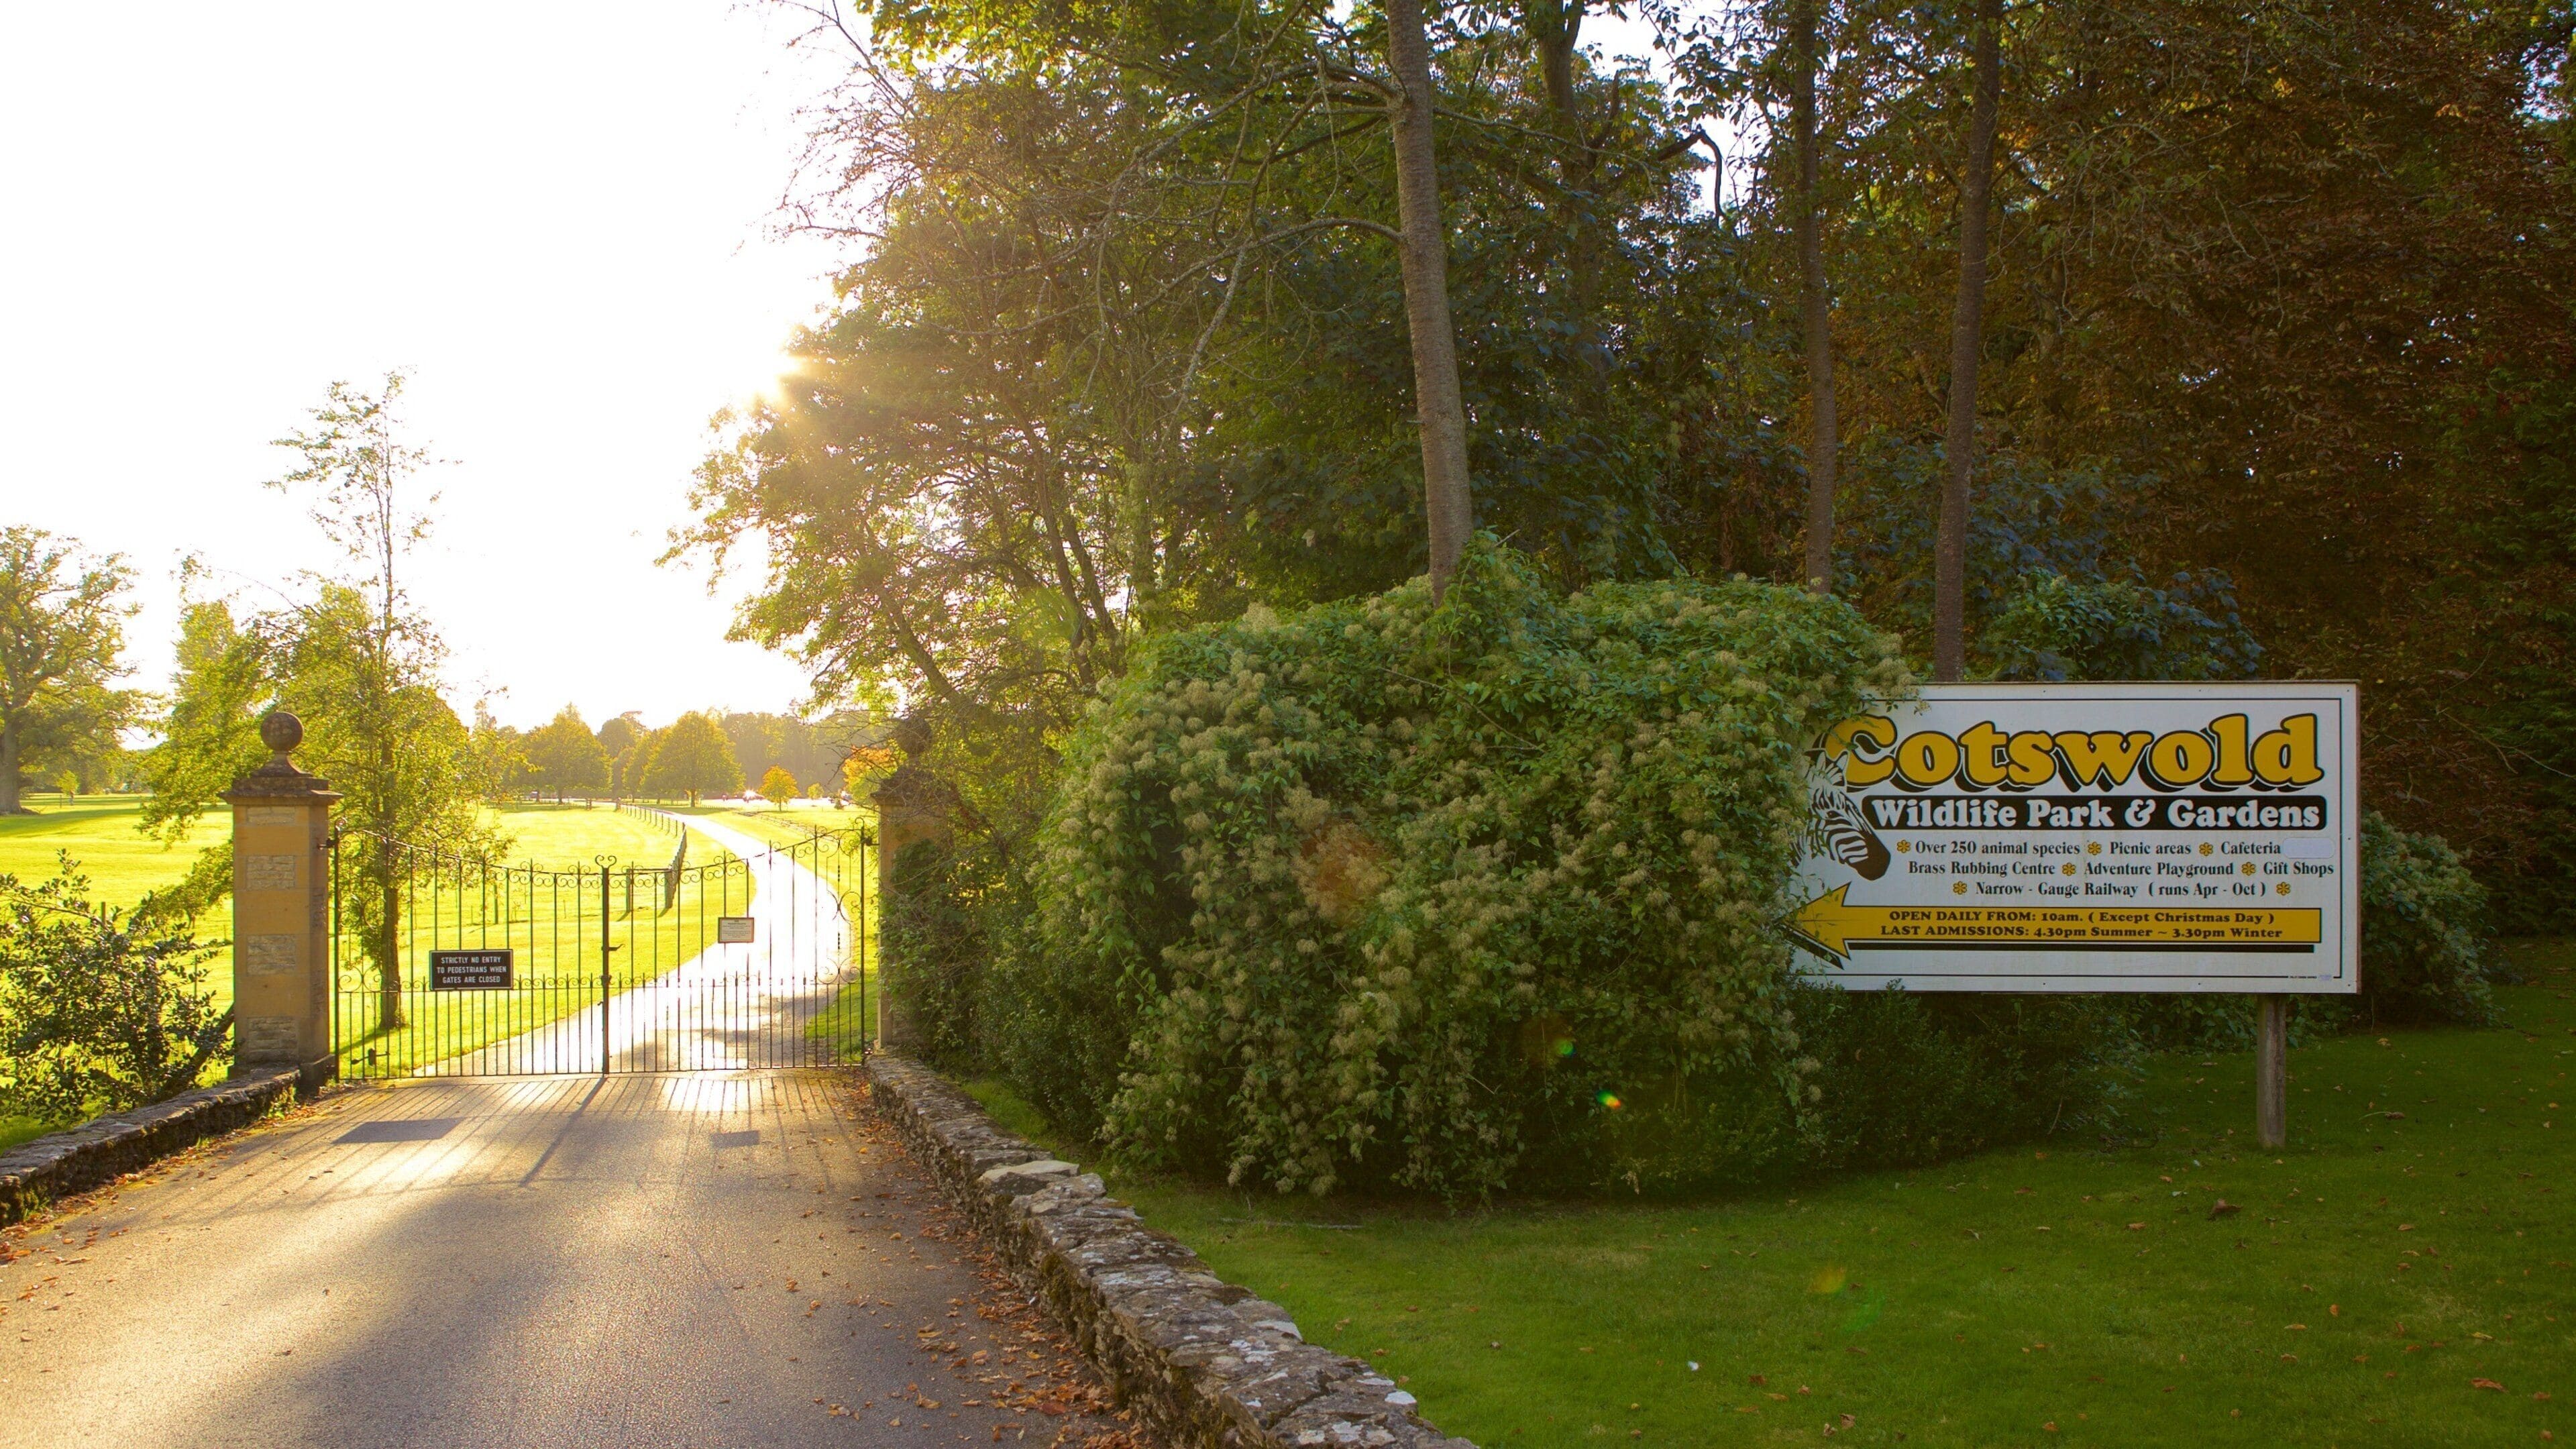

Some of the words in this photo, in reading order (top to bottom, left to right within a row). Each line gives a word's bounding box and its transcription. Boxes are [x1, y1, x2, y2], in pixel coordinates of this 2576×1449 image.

[1823, 713, 2325, 792] Cotswold
[1871, 799, 2017, 828] Wildlife
[2027, 799, 2114, 828] Park
[2125, 799, 2156, 828] &
[2167, 799, 2320, 828] Gardens
[1915, 841, 1946, 854] Over
[1951, 841, 1976, 854] 250
[1982, 841, 2027, 855] animal
[2033, 843, 2080, 857] species
[2110, 841, 2150, 855] Picnic
[2155, 843, 2191, 855] areas
[2220, 841, 2281, 855] Cafeteria
[1909, 861, 1945, 874] Brass
[1951, 861, 2007, 877] Rubbing
[2012, 861, 2055, 875] Centre
[2084, 861, 2151, 875] Adventure
[2157, 862, 2233, 878] Playground
[2263, 861, 2289, 875] Gift
[2293, 861, 2334, 877] Shops
[1976, 881, 2024, 895] Narrow
[2038, 881, 2079, 898] Gauge
[2084, 882, 2138, 898] Railway
[2159, 885, 2189, 896] runs
[2194, 882, 2218, 898] Apr
[2233, 882, 2256, 896] Oct
[1889, 910, 1931, 921] OPEN
[1936, 911, 1982, 921] DAILY
[1986, 911, 2036, 922] FROM:
[2041, 912, 2083, 922] 10am.
[2099, 912, 2150, 924] Except
[2155, 912, 2231, 923] Christmas
[2235, 912, 2263, 925] Day
[1881, 925, 1921, 936] LAST
[1925, 926, 2029, 936] ADMISSIONS:
[2033, 926, 2086, 938] 4.30pm
[2090, 927, 2153, 937] Summer
[2171, 927, 2225, 939] 3.30pm
[2230, 928, 2283, 938] Winter
[447, 966, 488, 974] PEDESTRIANS
